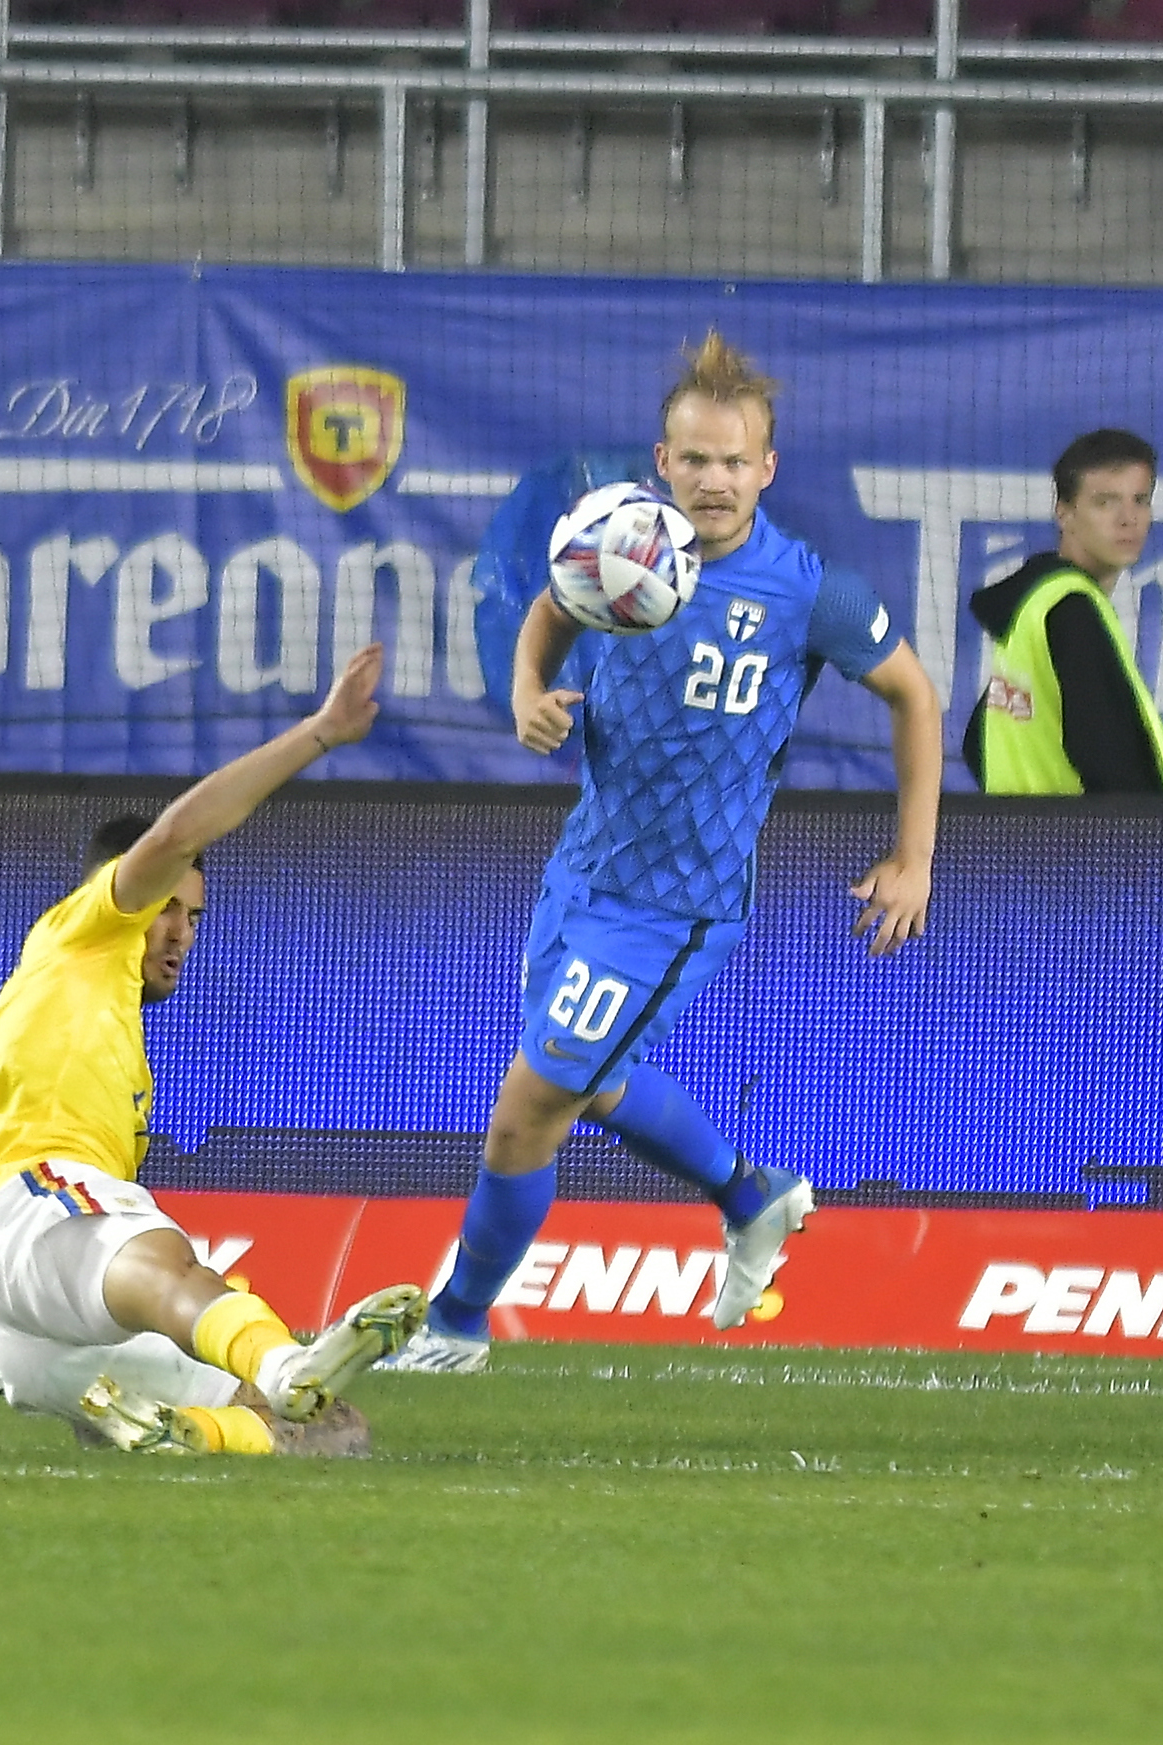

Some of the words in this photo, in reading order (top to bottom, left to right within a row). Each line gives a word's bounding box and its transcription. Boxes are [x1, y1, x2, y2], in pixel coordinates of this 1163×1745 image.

[121, 373, 258, 451] 1718
[324, 415, 366, 453] T
[683, 641, 769, 715] 20
[548, 959, 630, 1042] 20
[958, 1264, 1163, 1339] PEN
